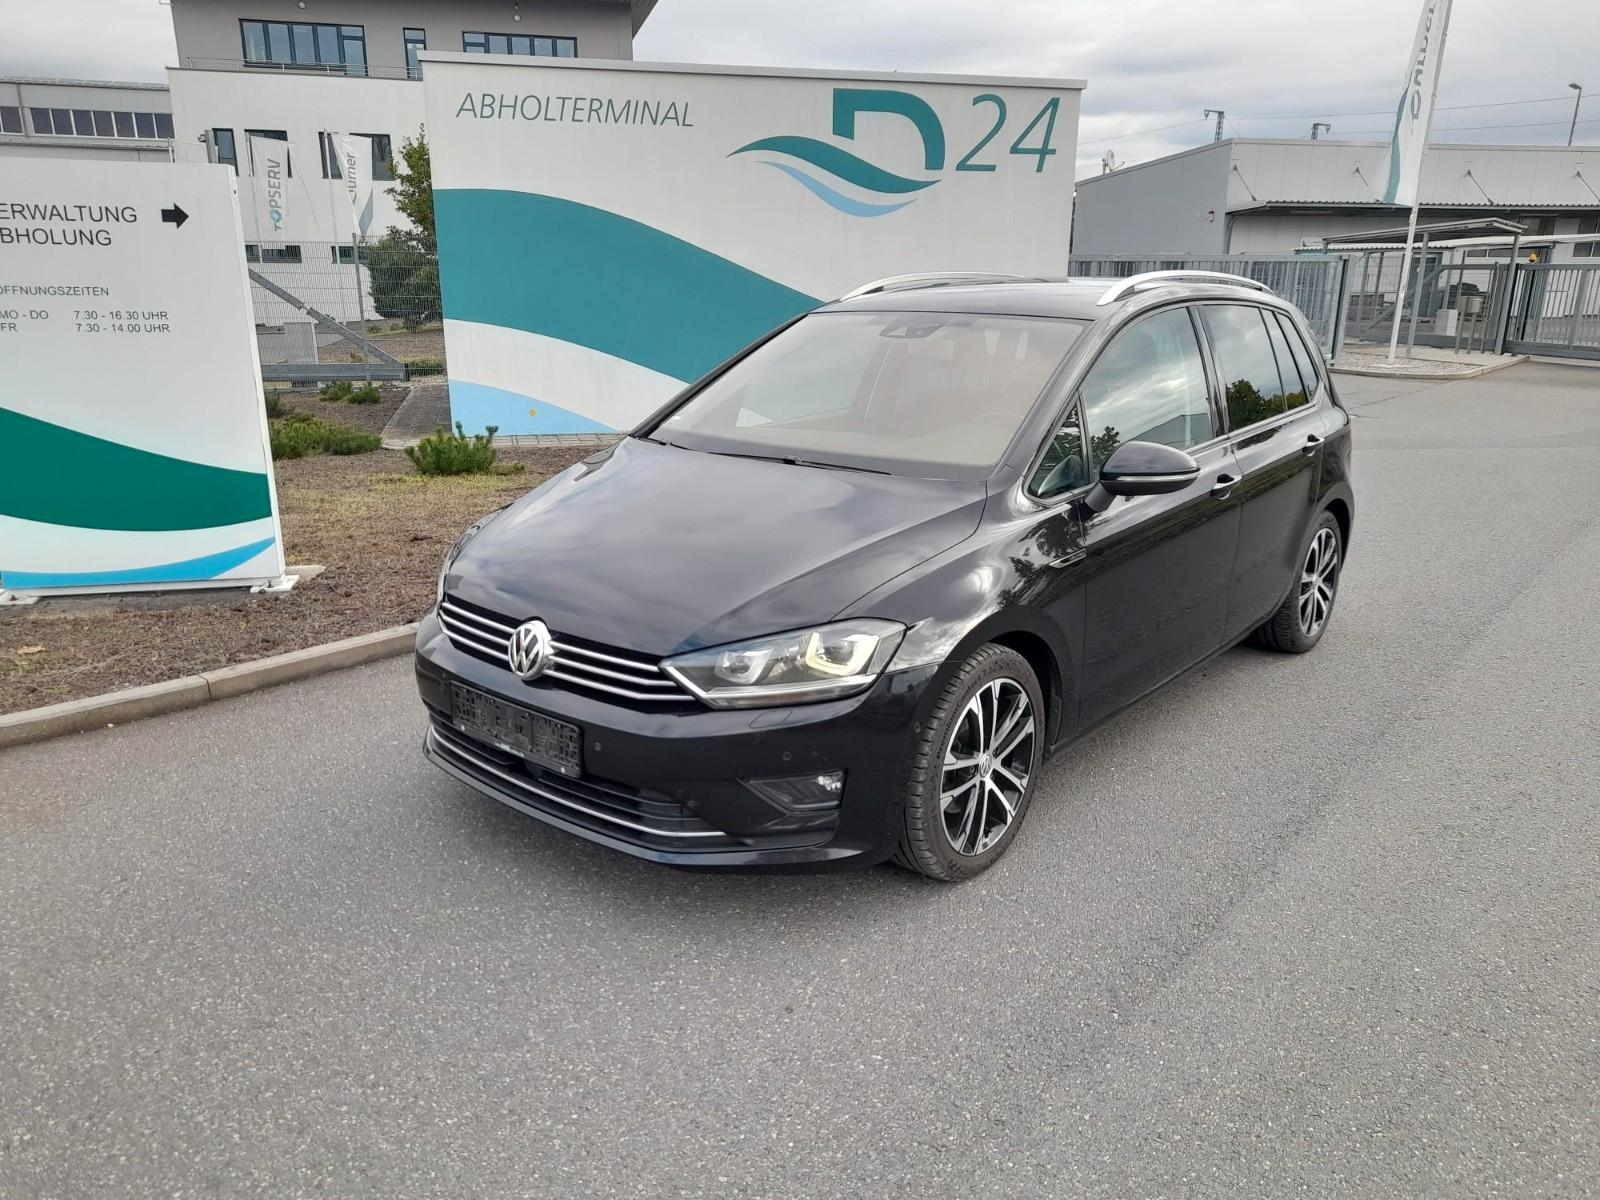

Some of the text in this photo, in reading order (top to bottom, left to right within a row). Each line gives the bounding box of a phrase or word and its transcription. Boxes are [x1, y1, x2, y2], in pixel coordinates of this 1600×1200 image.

[456, 92, 694, 128] ABHOLTERMINAL
[266, 158, 282, 232] TOPSERV
[0, 202, 138, 223] ERWALTUNG
[0, 227, 112, 246] BHOLUNG
[0, 309, 19, 320] MO
[30, 309, 49, 320] DO
[74, 310, 98, 320] 7.30
[110, 310, 140, 321] 16.30
[142, 311, 169, 321] UHR
[0, 322, 18, 332] FR
[76, 323, 100, 333] 7.30
[112, 323, 141, 333] 14.00
[144, 323, 171, 333] UHR
